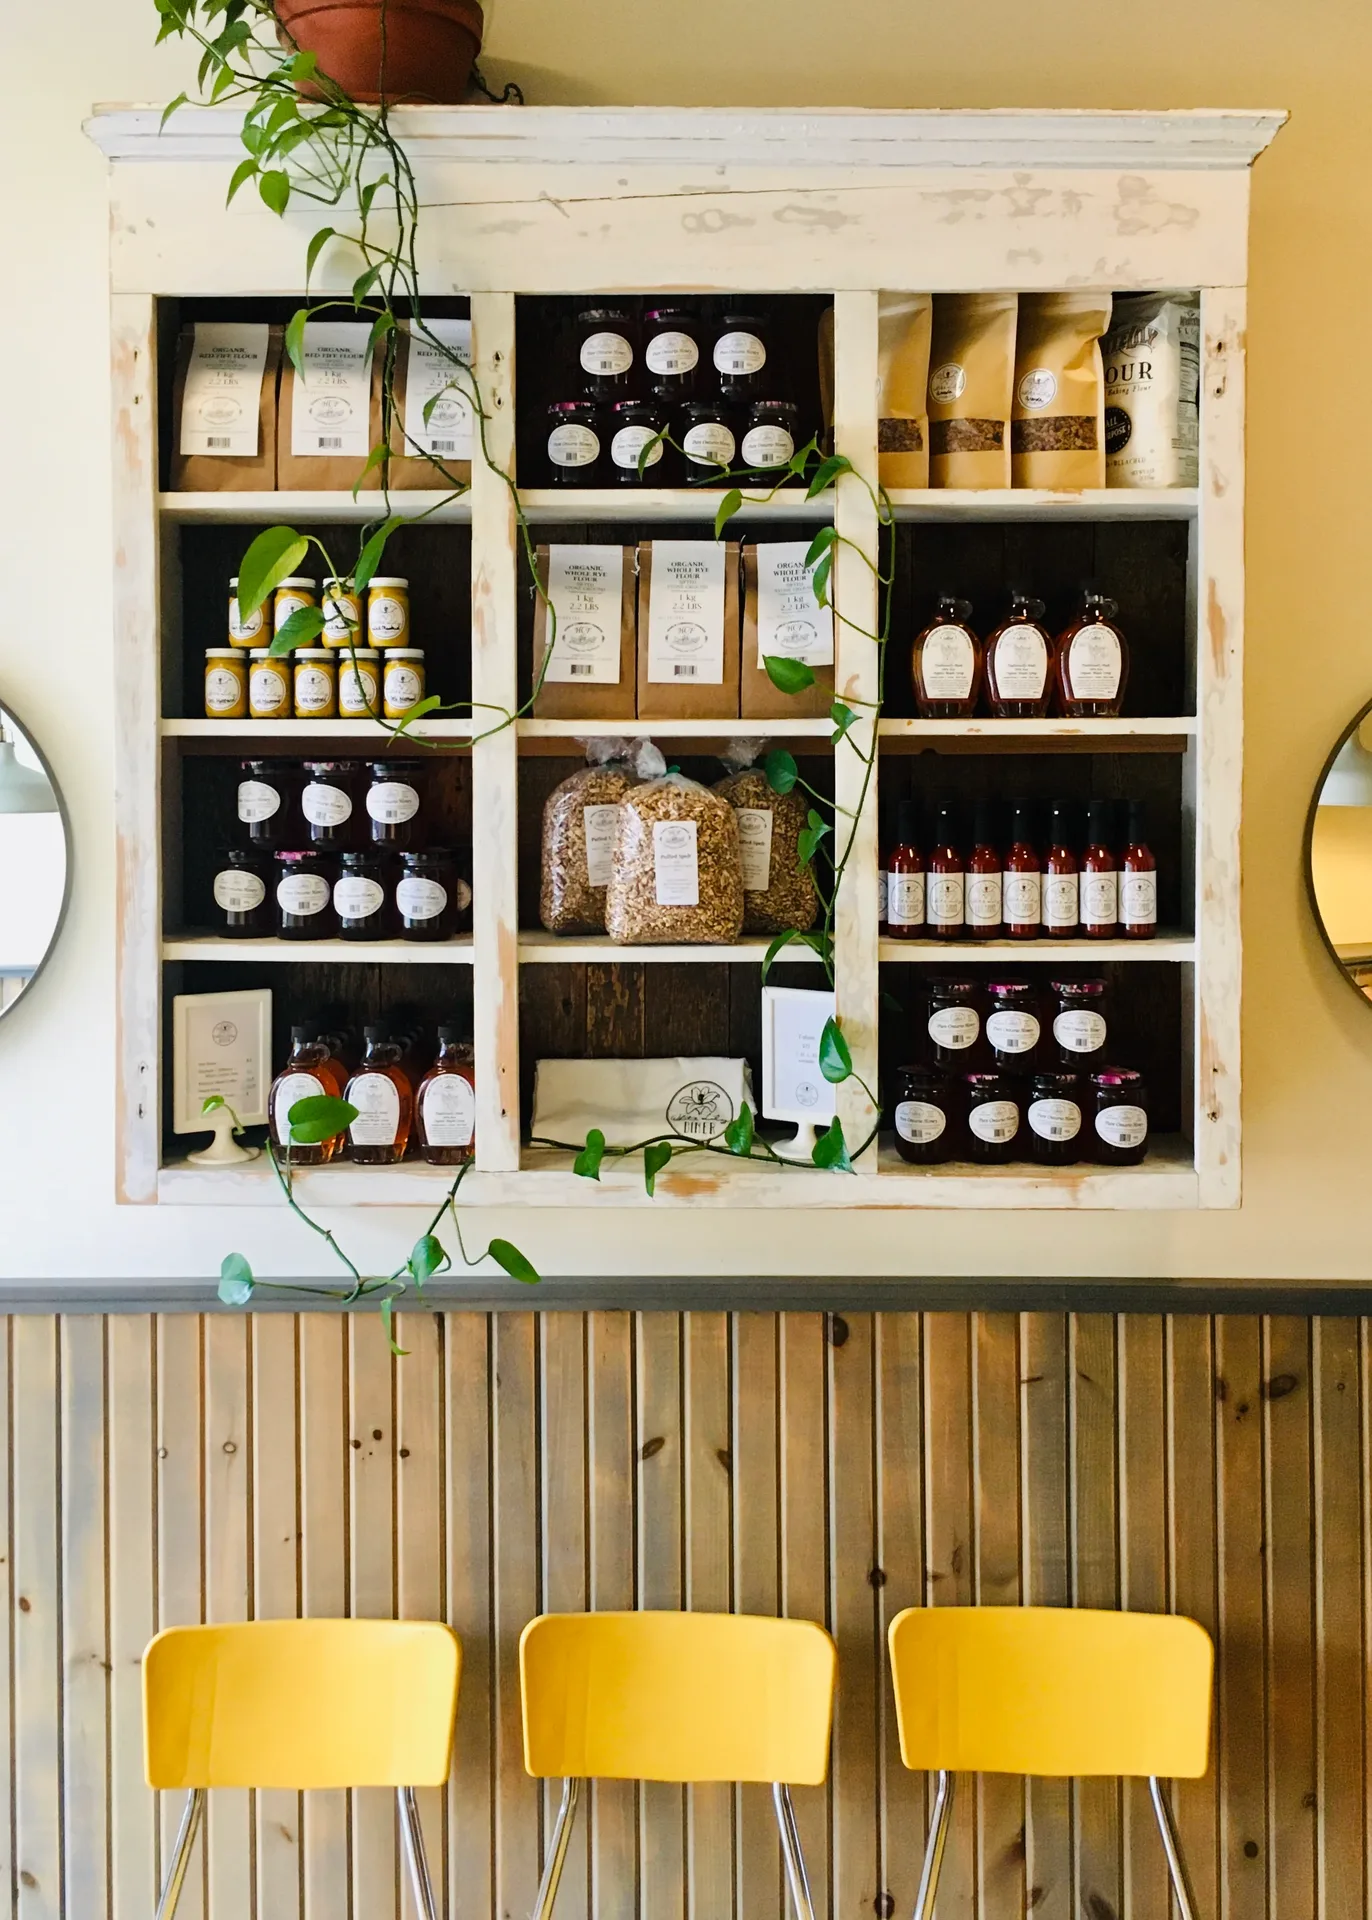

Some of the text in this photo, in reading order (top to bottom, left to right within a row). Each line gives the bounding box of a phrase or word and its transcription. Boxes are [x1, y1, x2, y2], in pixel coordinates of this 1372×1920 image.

[1105, 361, 1153, 384] OUR
[1132, 385, 1152, 393] Flour
[683, 1121, 716, 1135] DINER
